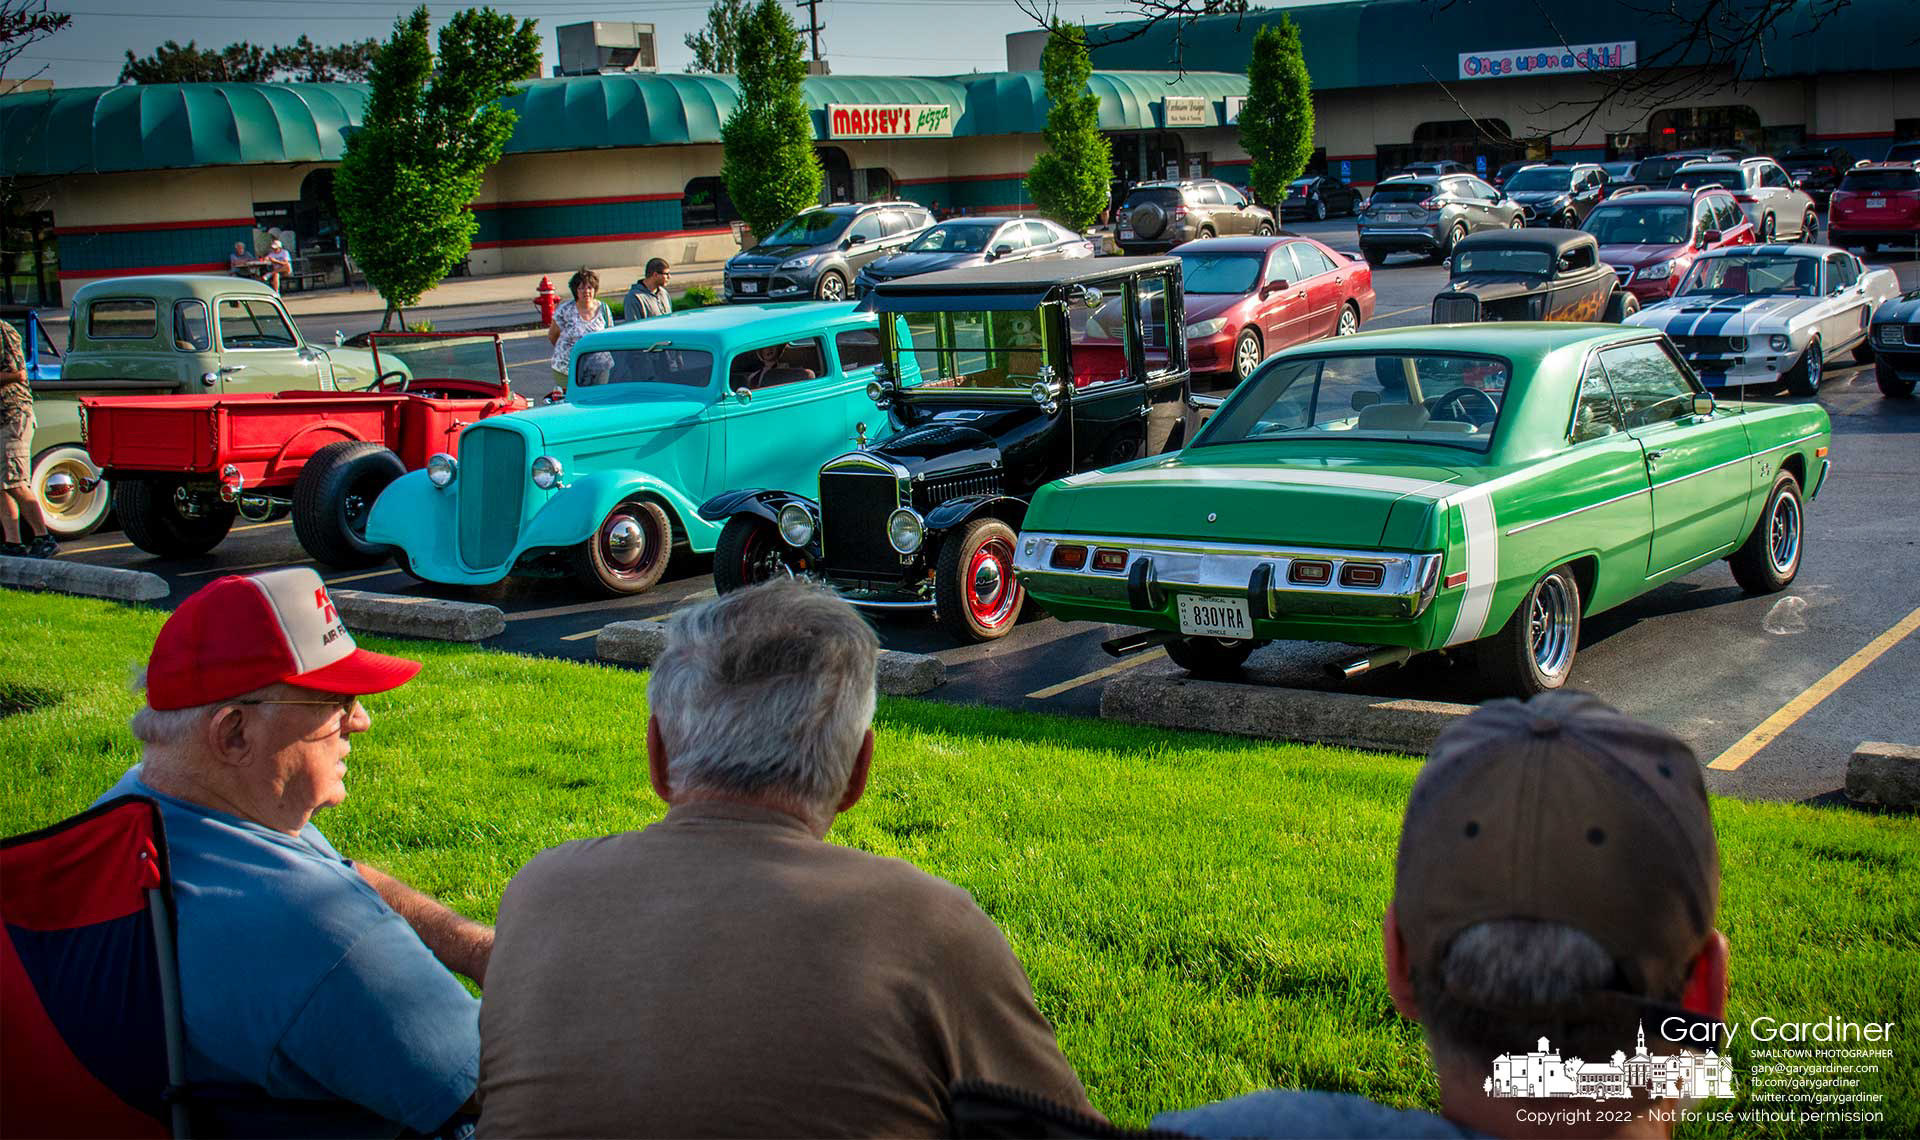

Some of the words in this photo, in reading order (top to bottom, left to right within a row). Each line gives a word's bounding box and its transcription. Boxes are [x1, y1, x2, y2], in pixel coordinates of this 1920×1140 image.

[1464, 56, 1512, 76] Once
[1516, 53, 1558, 72] upon
[1561, 54, 1574, 68] a
[833, 108, 911, 134] MASSEY'S
[916, 107, 948, 134] pizza
[1193, 605, 1244, 629] 830YRA
[323, 629, 338, 646] AIR
